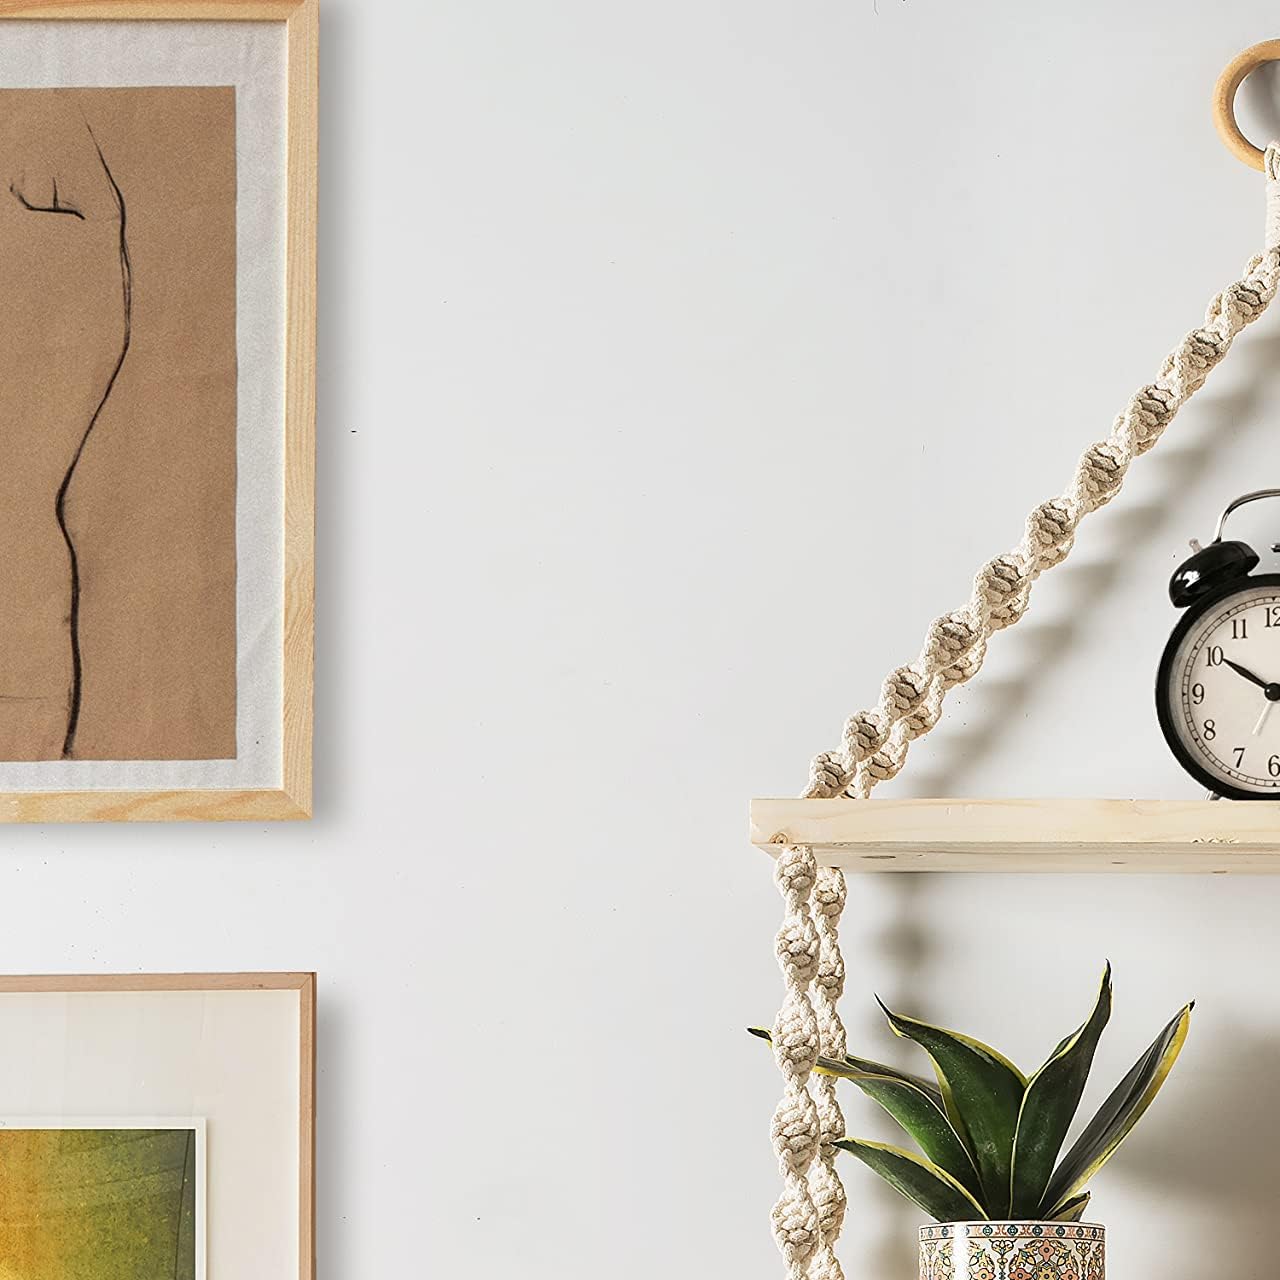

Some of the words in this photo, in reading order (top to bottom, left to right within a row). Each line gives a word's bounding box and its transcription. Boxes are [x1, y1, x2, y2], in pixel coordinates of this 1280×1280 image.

[1232, 619, 1248, 639] 11
[1206, 646, 1223, 666] 10
[1192, 684, 1205, 704] 9
[1203, 720, 1216, 740] 8
[1233, 748, 1245, 768] 7
[1268, 755, 1280, 777] 6
